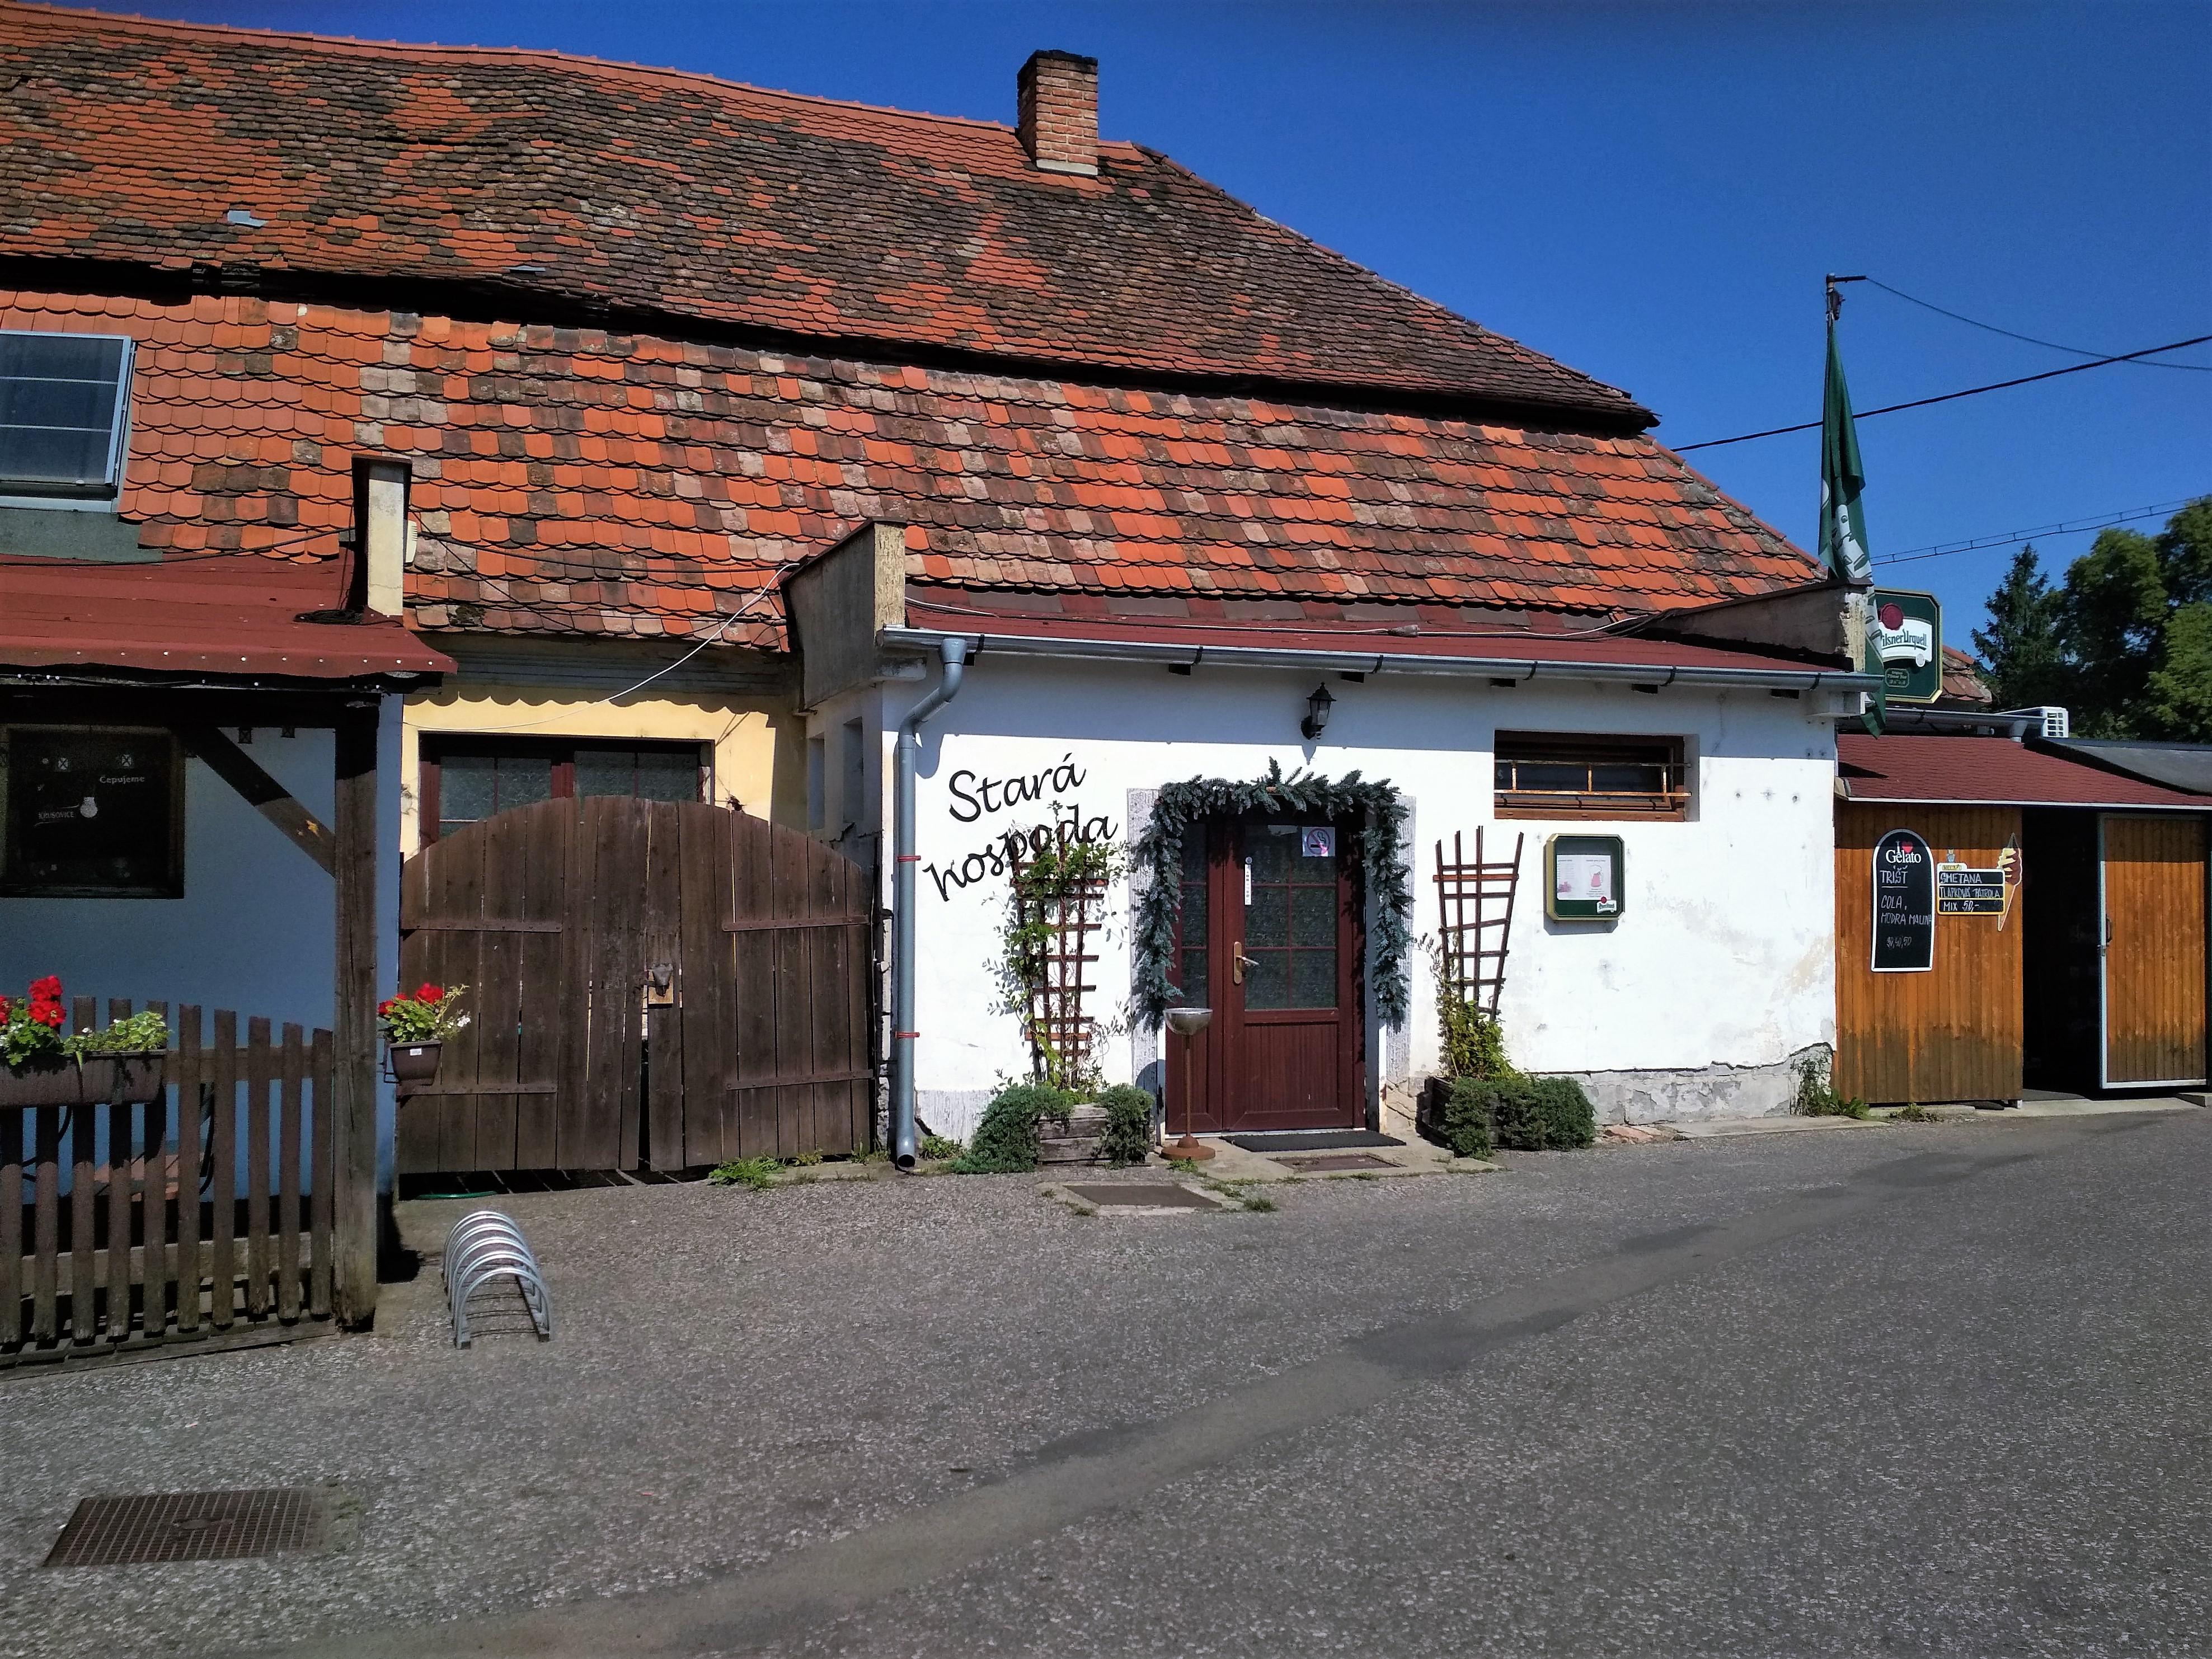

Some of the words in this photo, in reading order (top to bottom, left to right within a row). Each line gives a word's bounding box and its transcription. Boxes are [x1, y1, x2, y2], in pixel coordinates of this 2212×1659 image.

[1881, 633, 1904, 647] ilsner
[1903, 628, 1927, 650] Urquell
[949, 753, 1087, 823] Stará
[922, 804, 1119, 901] hospoda
[1896, 841, 1901, 854] I
[1885, 849, 1922, 863] Gelato
[1940, 872, 1982, 884] SMETANA
[1973, 888, 2000, 899] PATROLA
[1943, 901, 1958, 912] MIX
